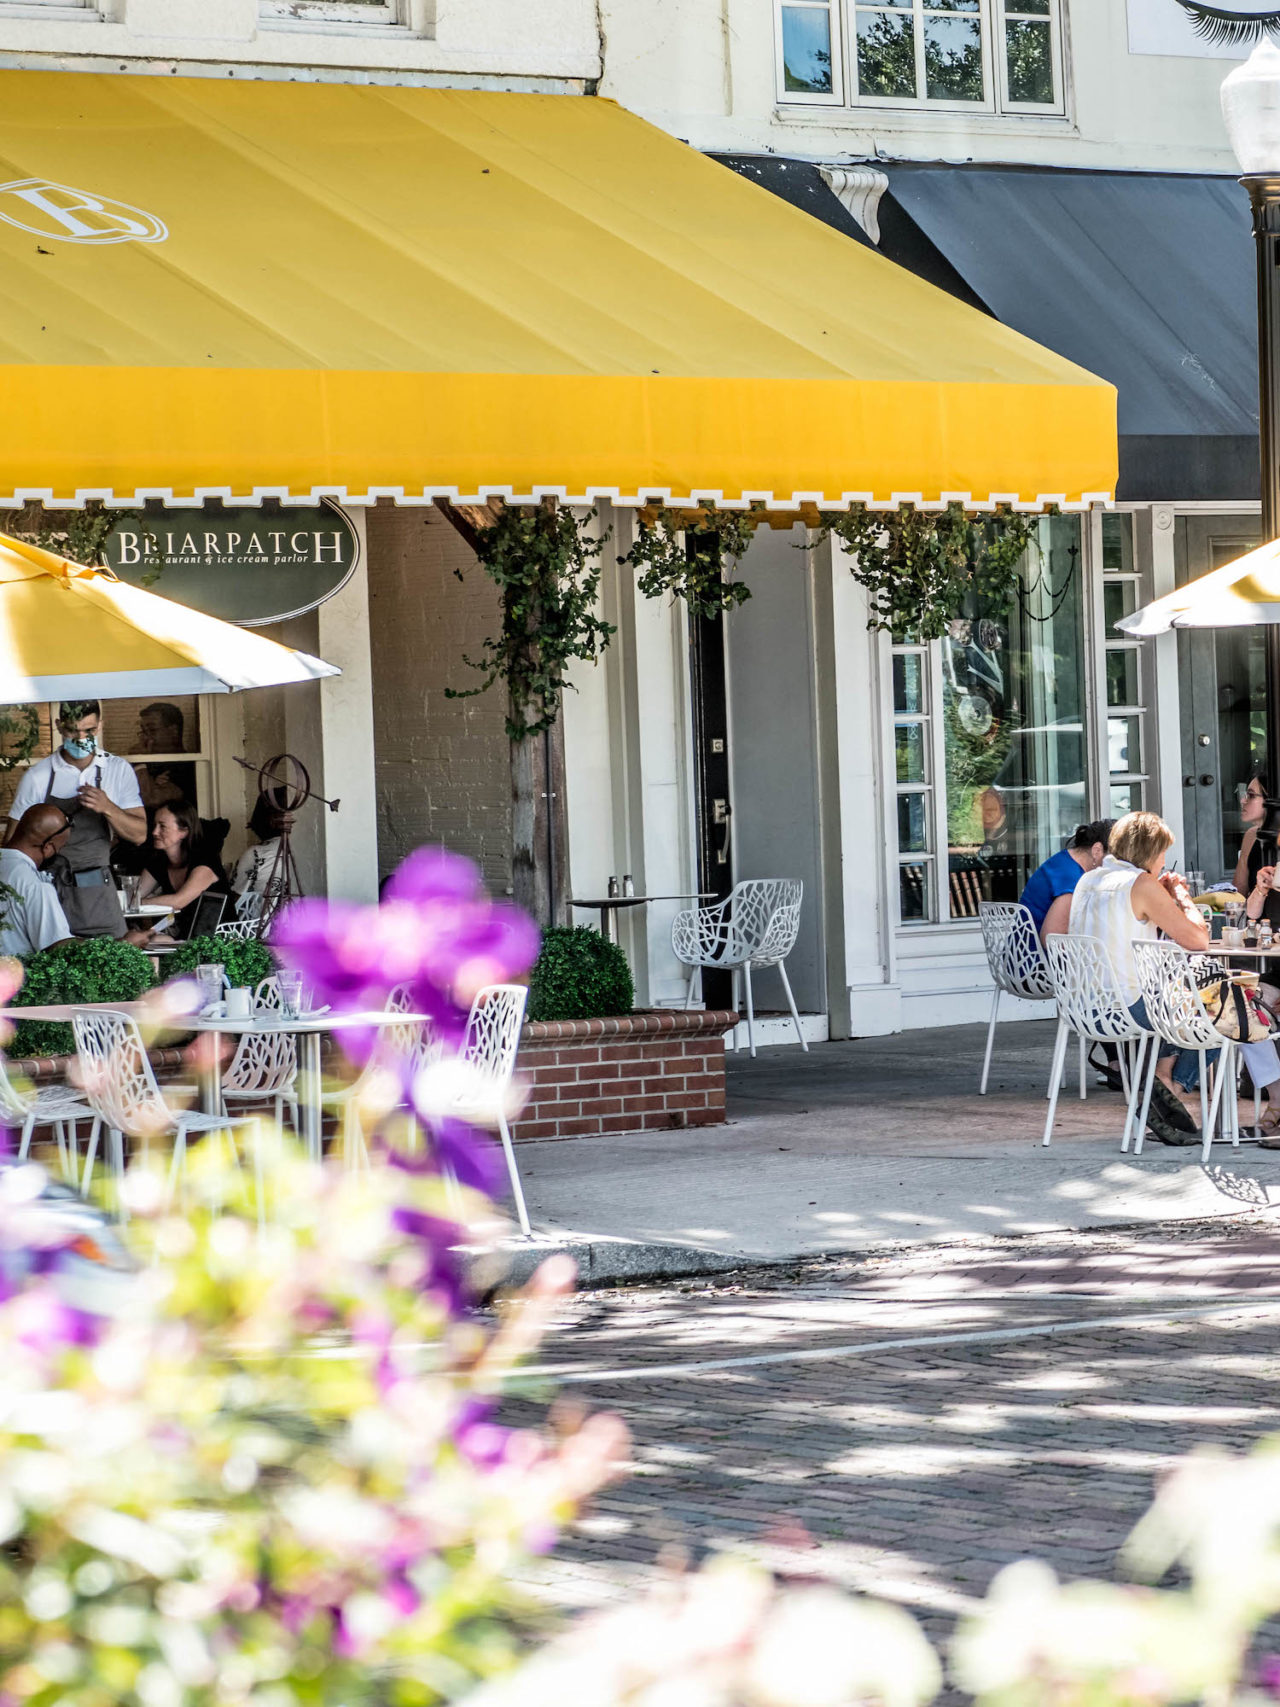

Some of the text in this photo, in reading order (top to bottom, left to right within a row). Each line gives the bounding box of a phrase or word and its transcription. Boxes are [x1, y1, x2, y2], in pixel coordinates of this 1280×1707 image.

[143, 555, 201, 565] resaurant
[217, 555, 234, 564] ice
[237, 556, 269, 564] cream
[273, 553, 309, 566] parlor
